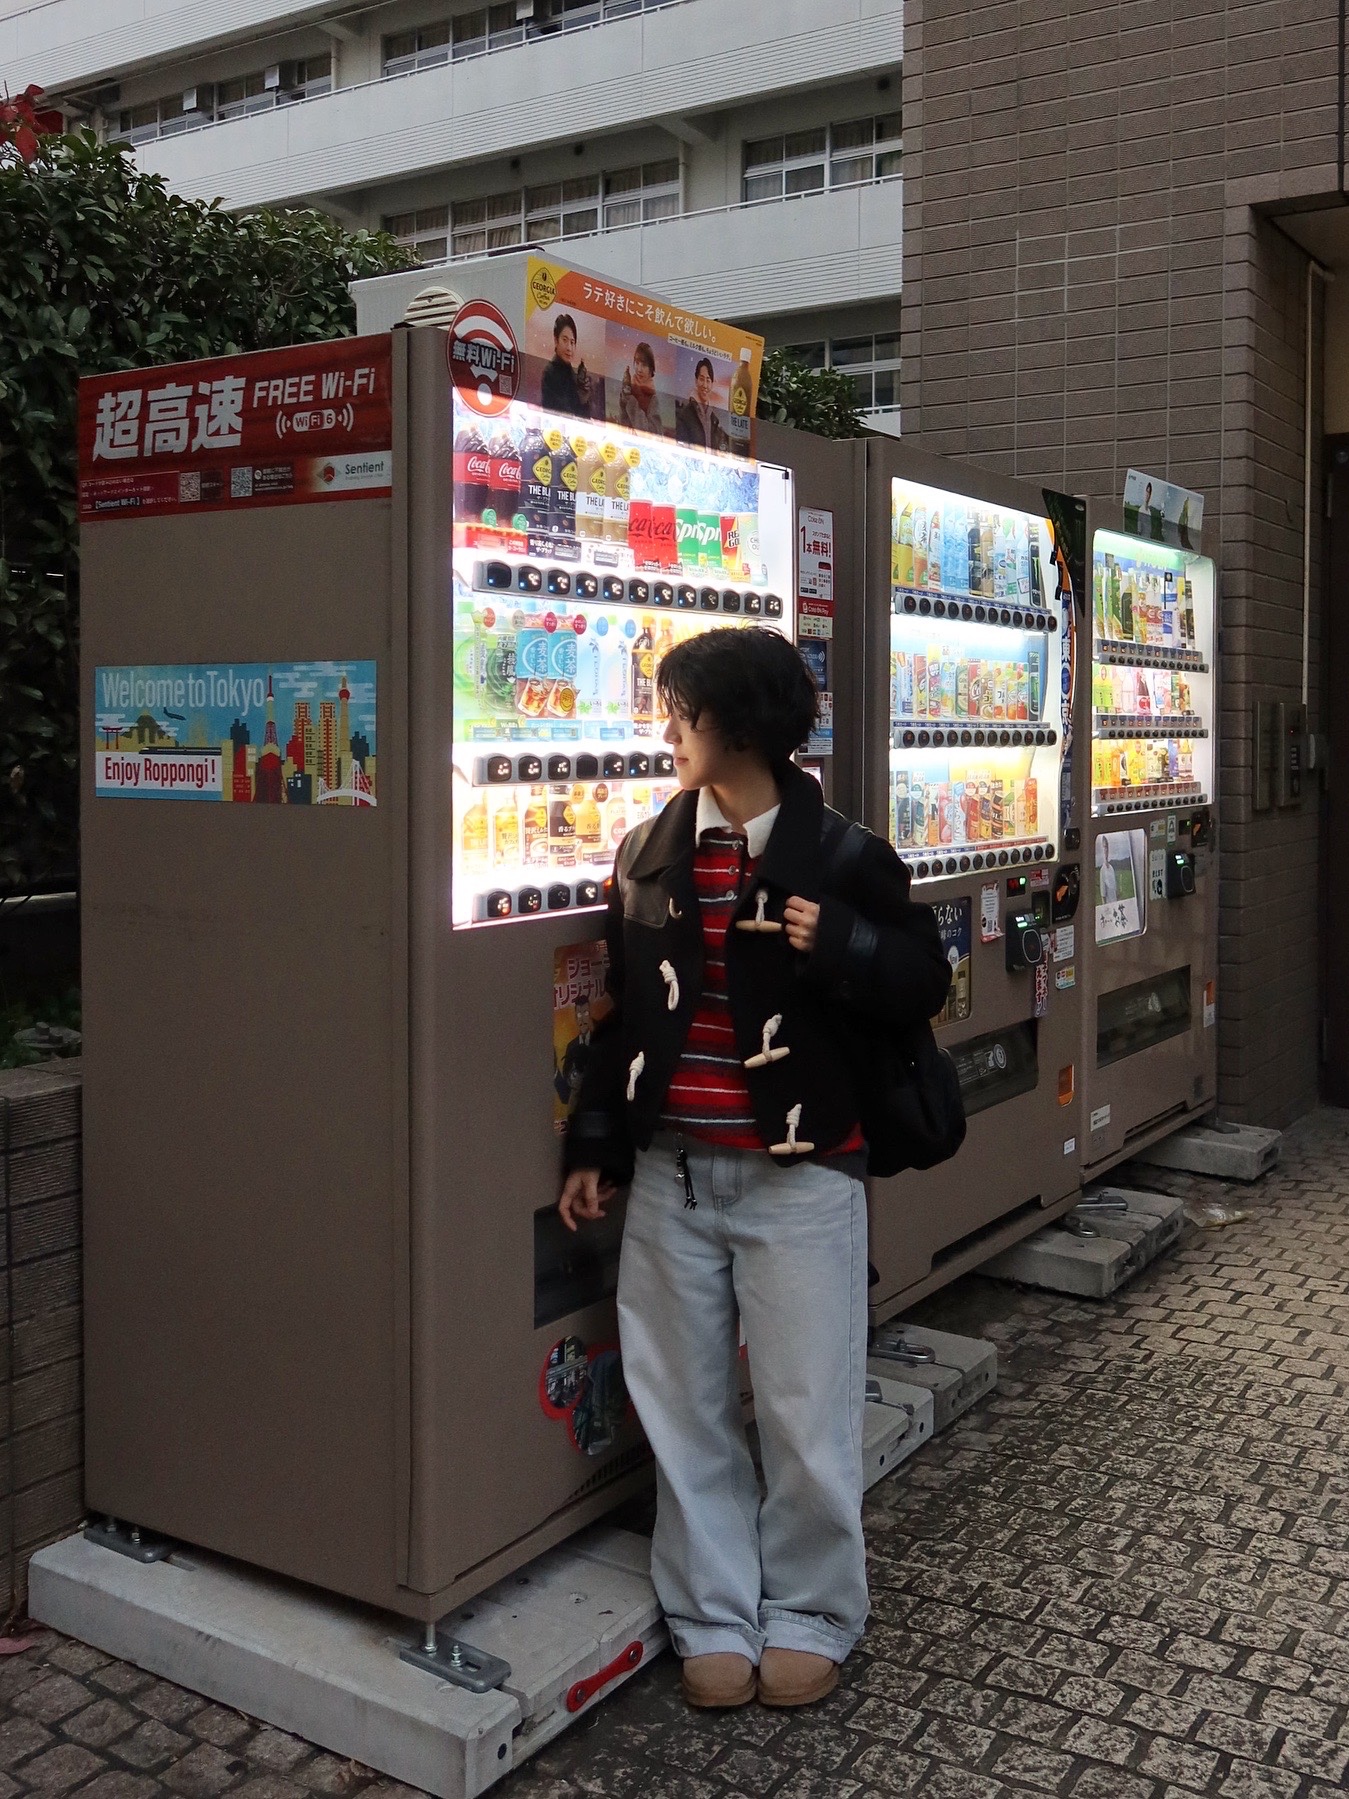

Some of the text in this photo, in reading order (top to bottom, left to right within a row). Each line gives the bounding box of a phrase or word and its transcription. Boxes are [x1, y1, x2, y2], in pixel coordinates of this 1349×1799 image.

[532, 281, 555, 295] GEORGIA
[583, 282, 717, 343] ラテ好きにこそ飲んで欲しい。
[452, 340, 515, 374] 無料Wi-Fi
[252, 367, 376, 408] FREE Wi-Fi
[92, 374, 247, 462] 超高速
[326, 411, 333, 424] 6
[345, 461, 384, 475] Sentient
[528, 484, 542, 496] THE
[557, 490, 570, 501] THE
[586, 496, 598, 507] THE
[611, 501, 623, 511] THE
[537, 641, 549, 675] 麦茶
[565, 642, 577, 674] 麦茶
[102, 669, 265, 716] Welcome to Tokyo
[105, 756, 140, 786] Enjoy
